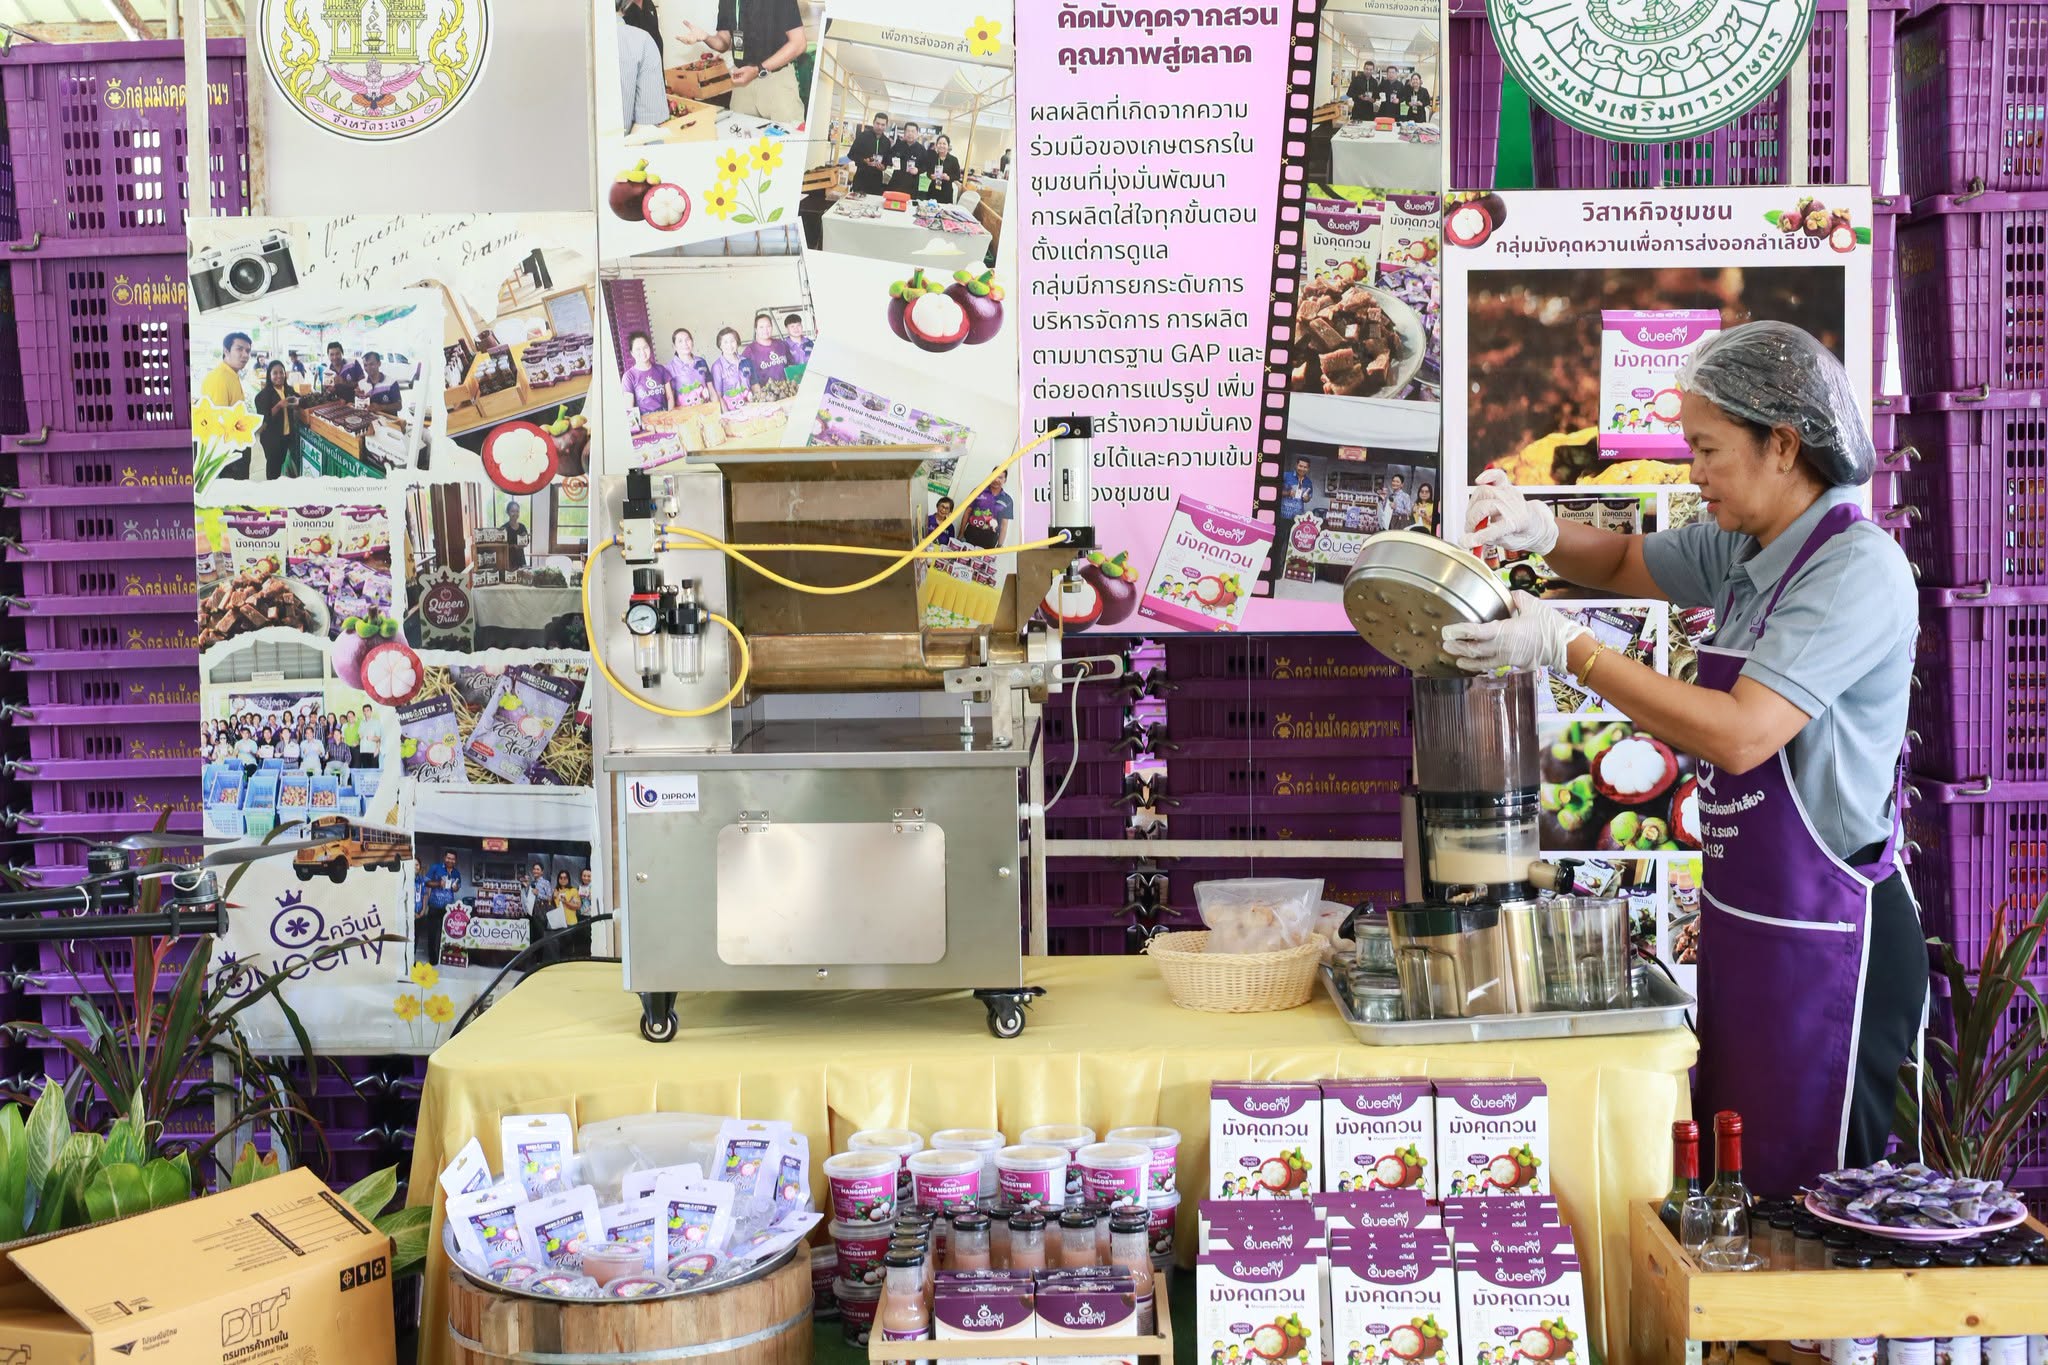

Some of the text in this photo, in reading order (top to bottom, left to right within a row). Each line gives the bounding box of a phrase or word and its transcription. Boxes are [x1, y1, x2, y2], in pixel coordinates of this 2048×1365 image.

[1057, 2, 1278, 36] คัดมังคุดจากสวน
[1058, 38, 1252, 73] คุณภาพสู่ตลาด
[1532, 28, 1784, 121] กรมส่งเสริมการเกษตร
[1031, 94, 1248, 121] ผลผลิตที่เกิดจากความ
[333, 113, 415, 131] จังหวัดระนอง
[1030, 131, 1253, 156] ร่วมมือของเกษตรกรใน
[1031, 166, 1225, 196] ชุมชนที่มุ่งมั่นพัฒนา
[1031, 200, 1256, 230] การผลิตใส่ใจทุกขั้นตอน
[1583, 202, 1732, 227] วิสาหกิจชุมชน
[1032, 237, 1168, 266] ตั้งแต่การดูแล
[1496, 233, 1821, 257] กลุ่มมังคุดหวานเพื่อการส่งออกลำเลียง
[1032, 273, 1244, 301] กลุ่มมีการยกระดับการ
[1033, 309, 1248, 330] บริหารจัดการ การผลิต
[1638, 327, 1688, 344] Queeny
[1033, 343, 1263, 369] ตามมาตรฐาน GAP และ
[1033, 378, 1254, 404] ต่อยอดการแปรรูป เพิ่ม
[1202, 518, 1246, 543] Queeny
[1176, 531, 1254, 569] มังคุดกวน
[1318, 536, 1363, 553] Quee
[428, 598, 465, 613] Queen
[436, 614, 460, 624] Fruit
[661, 792, 696, 800] DIPROM
[329, 904, 382, 940] ควีนนี่
[469, 922, 527, 942] Queeny
[1244, 1096, 1290, 1113] Queeny
[1356, 1095, 1403, 1111] Queeny
[1470, 1095, 1517, 1110] Queeny
[1222, 1118, 1308, 1143] มังคุดกวน
[1336, 1117, 1422, 1141] มังคุดกวน
[1449, 1116, 1536, 1141] มังคุดกวน
[840, 1186, 883, 1196] MANGOSTEEN
[928, 1184, 971, 1194] MANGOSTEEN
[1361, 1212, 1409, 1228] Queeny
[1232, 1261, 1284, 1278] Queeny
[1367, 1264, 1419, 1280] Queeny
[1495, 1267, 1547, 1284] Queeny
[1210, 1283, 1305, 1309] มังคุดกวน
[1345, 1285, 1441, 1310] มังคุดกวน
[1473, 1288, 1570, 1313] มังคุดกวน
[962, 1314, 1004, 1328] Queeny
[1064, 1312, 1106, 1326] Queeny
[222, 1330, 289, 1362] กรมการค้าภายใน
[276, 1342, 289, 1353] Trade
